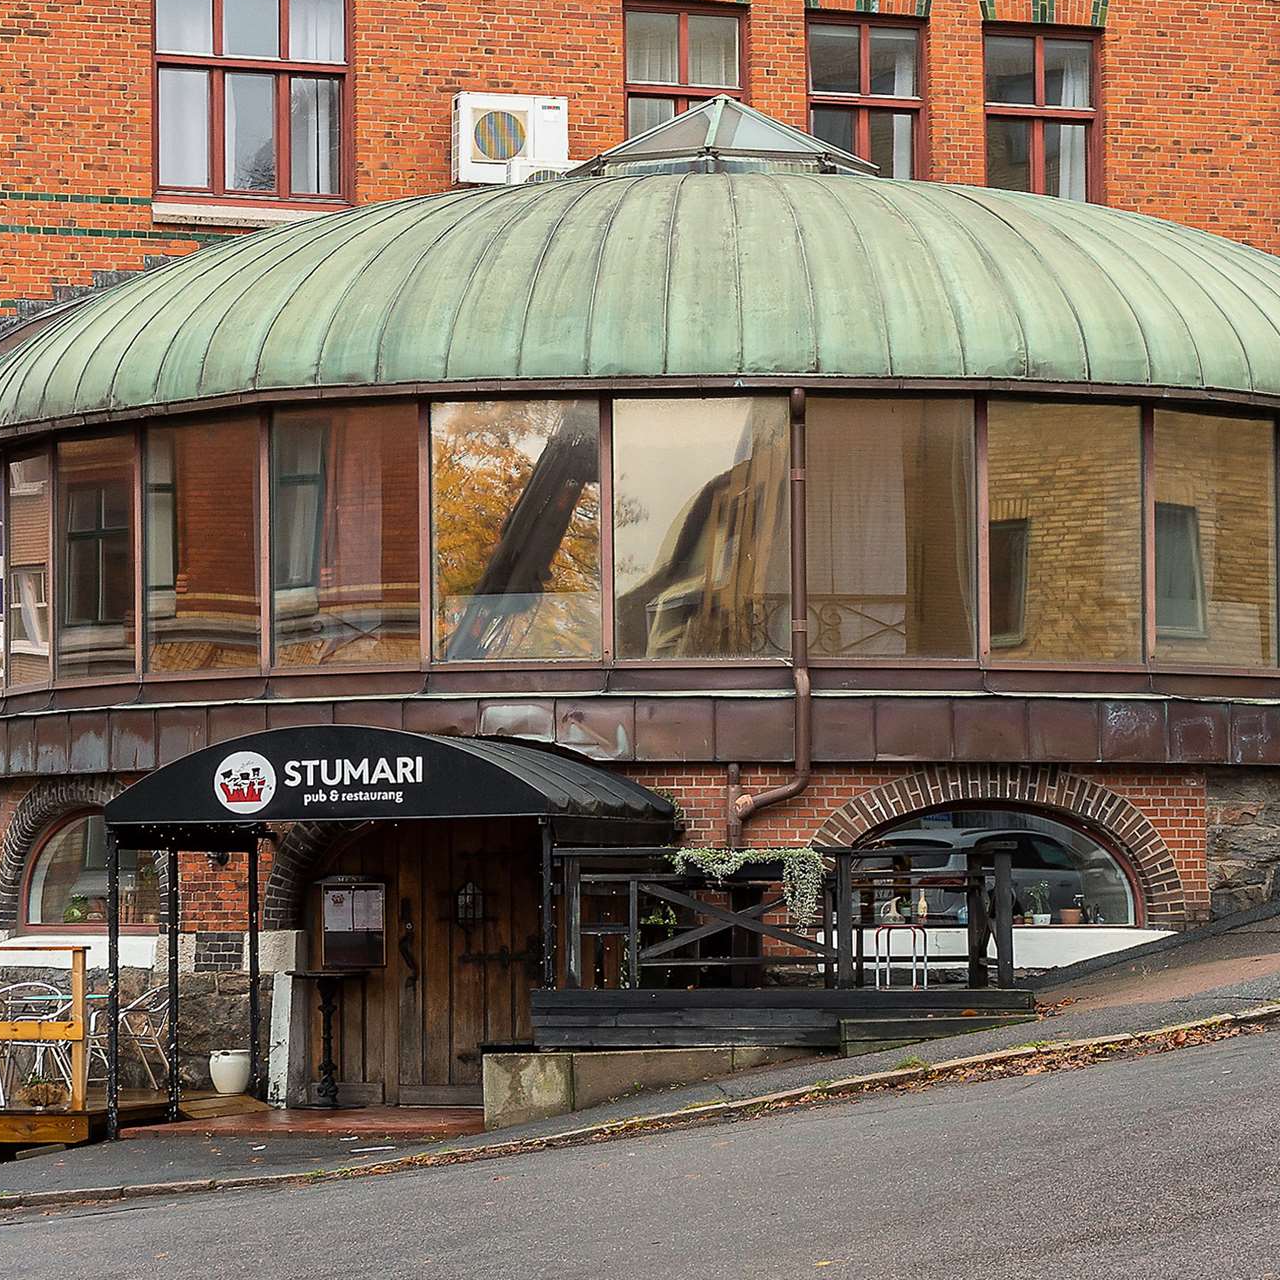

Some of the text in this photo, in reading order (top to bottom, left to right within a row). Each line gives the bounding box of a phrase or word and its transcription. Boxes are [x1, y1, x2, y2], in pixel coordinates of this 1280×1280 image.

[284, 756, 423, 787] STUMARI
[303, 789, 404, 806] pub & restaurang
